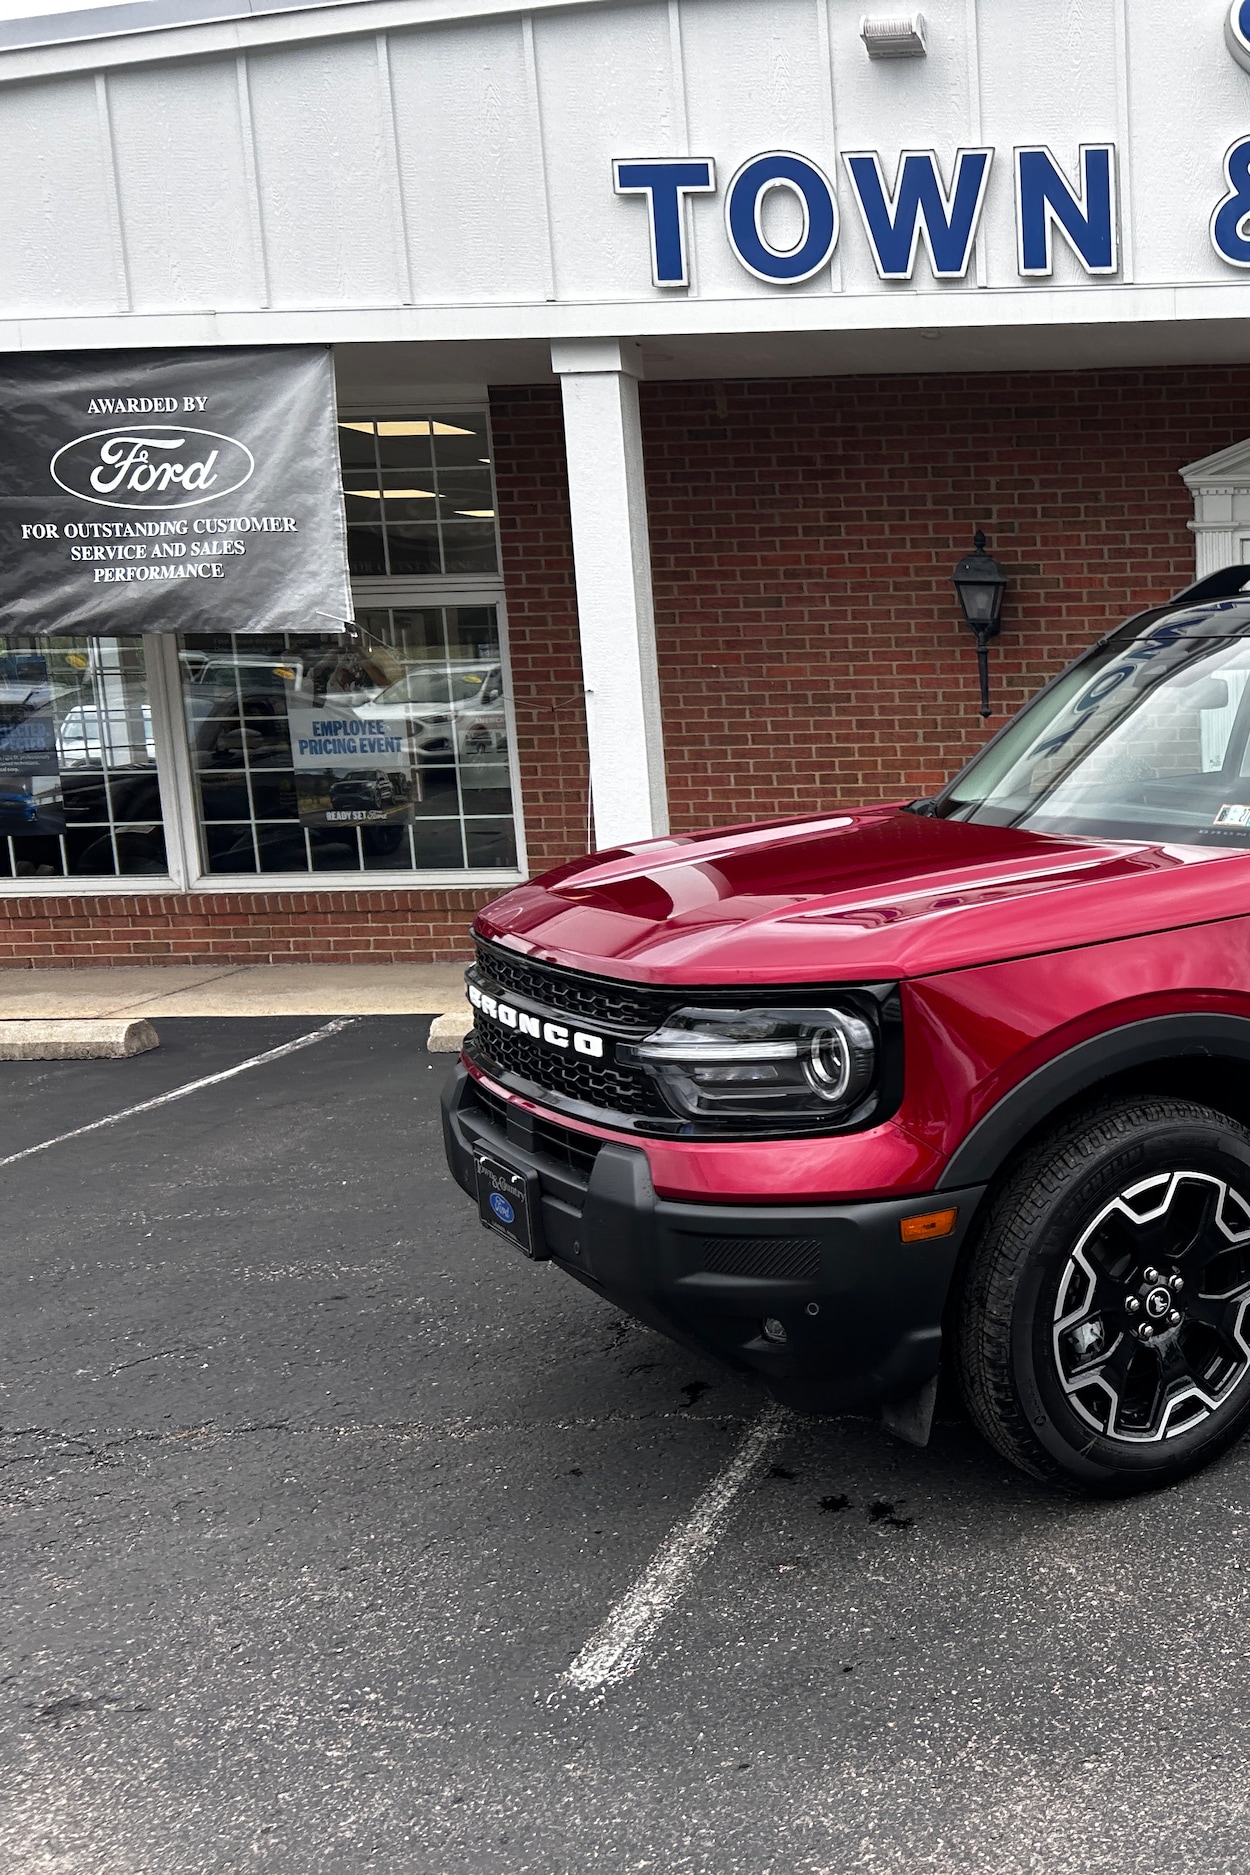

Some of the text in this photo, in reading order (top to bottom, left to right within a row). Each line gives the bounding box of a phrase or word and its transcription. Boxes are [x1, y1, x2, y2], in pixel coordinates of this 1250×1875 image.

[613, 143, 1120, 289] TOWN
[87, 396, 208, 413] AWARDED BY
[90, 437, 219, 493] Ford
[21, 517, 298, 539] FOR OUTSTANDING CUSTOMER
[71, 540, 246, 560] SERVICE AND SALES
[94, 563, 225, 583] PERFORMANCE
[312, 720, 385, 737] EMPLOYEE
[299, 737, 403, 755] PRICING EVENT
[325, 811, 351, 821] READY
[352, 810, 367, 820] SET
[469, 985, 603, 1058] BRONCO
